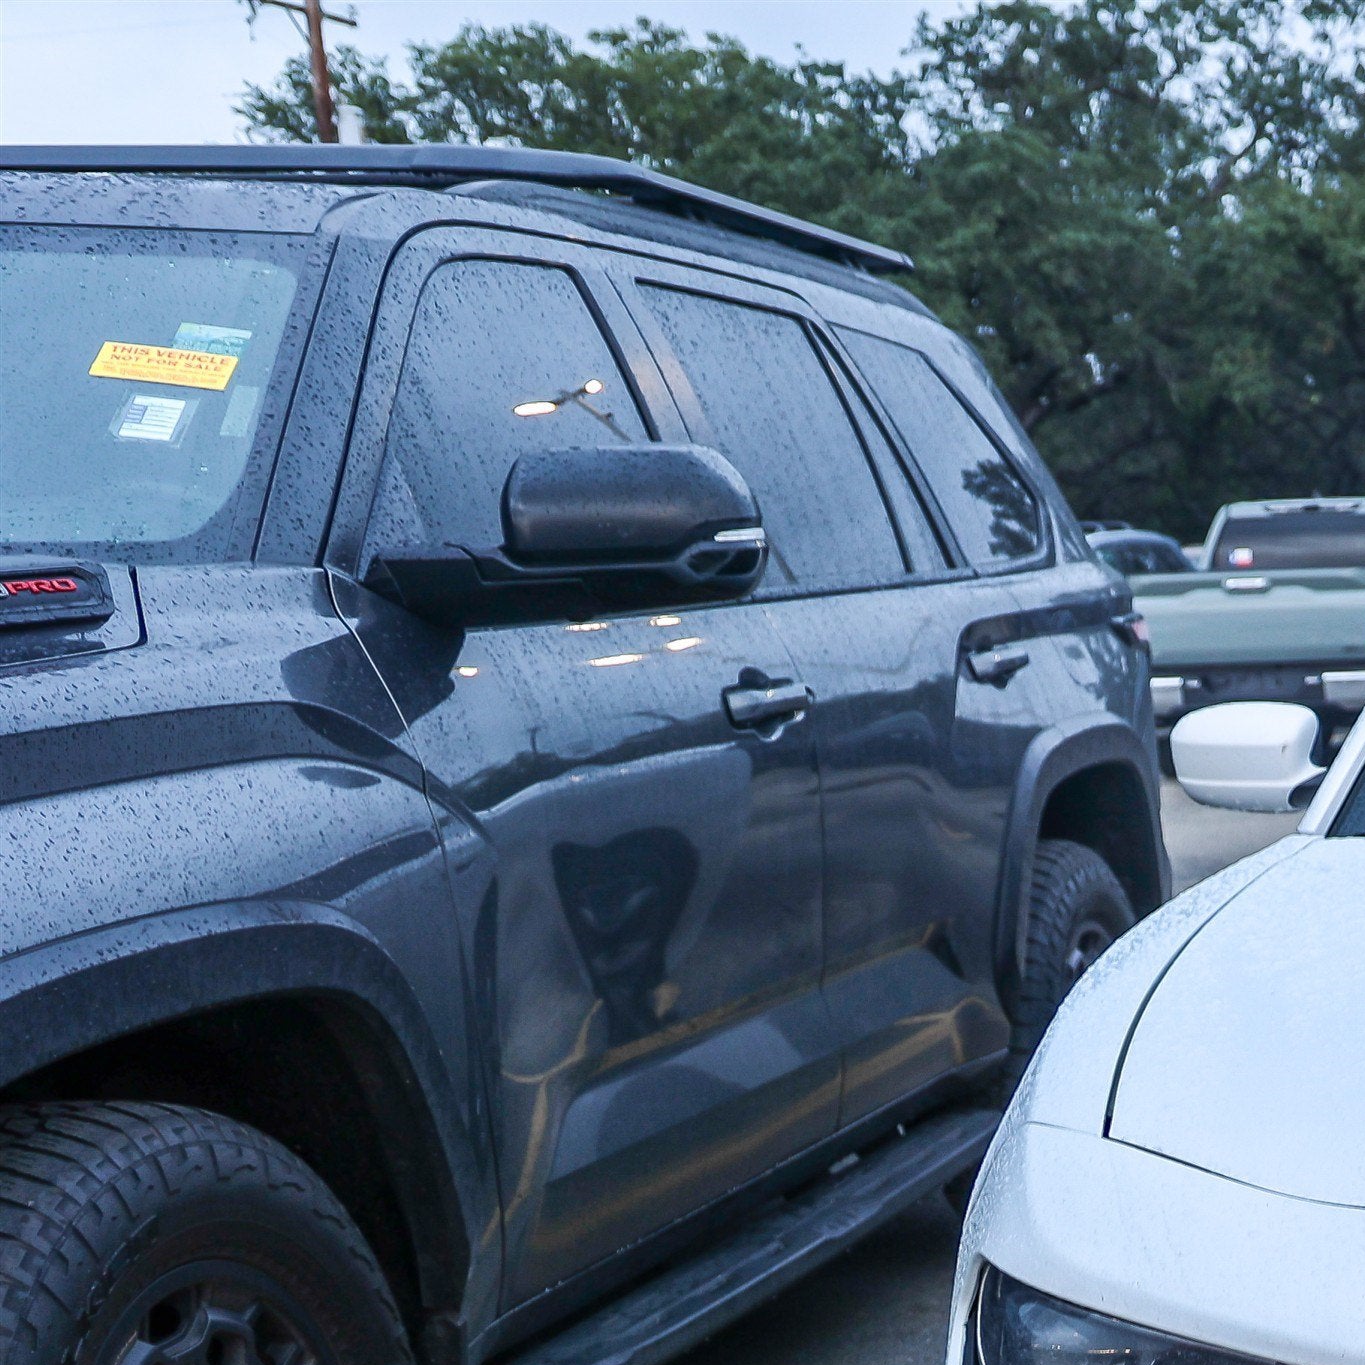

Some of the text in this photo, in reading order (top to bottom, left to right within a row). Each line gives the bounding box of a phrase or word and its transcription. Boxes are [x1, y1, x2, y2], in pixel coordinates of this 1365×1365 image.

[111, 345, 230, 365] THIS VEHICLE
[111, 354, 140, 363] NOT
[147, 358, 178, 367] FOR
[184, 362, 223, 372] SALE
[4, 578, 77, 595] PRO
